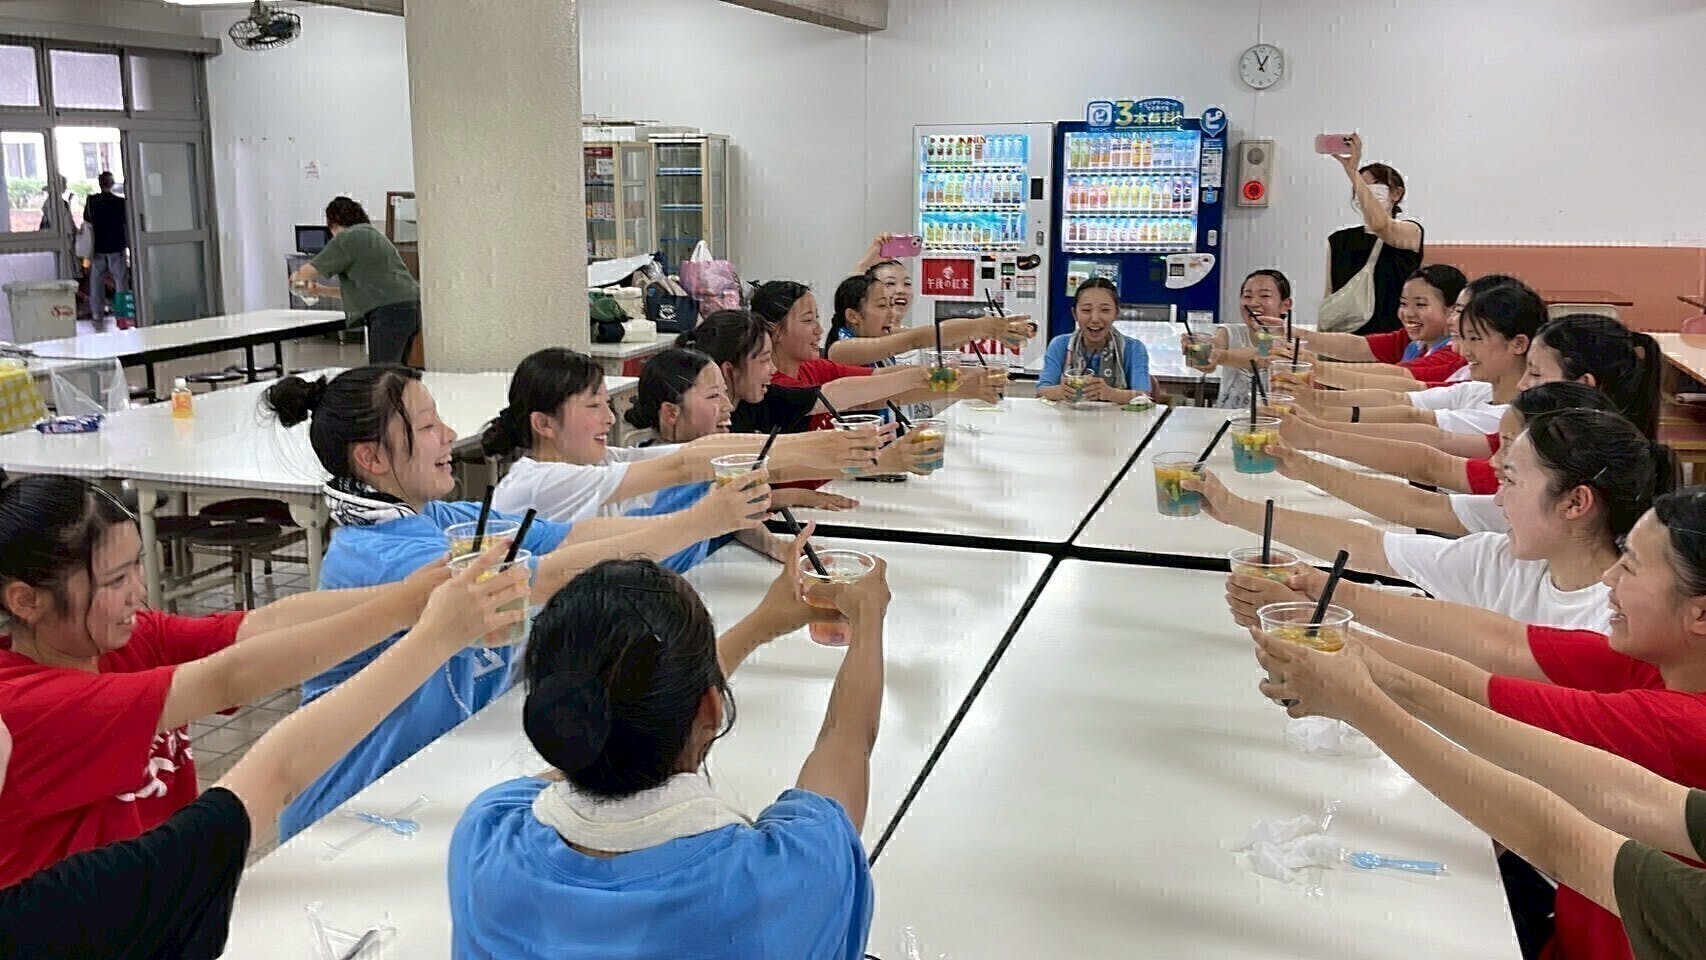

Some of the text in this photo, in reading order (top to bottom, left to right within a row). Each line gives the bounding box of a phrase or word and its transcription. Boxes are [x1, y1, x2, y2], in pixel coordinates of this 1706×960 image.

[927, 278, 969, 290] 午後の紅茶
